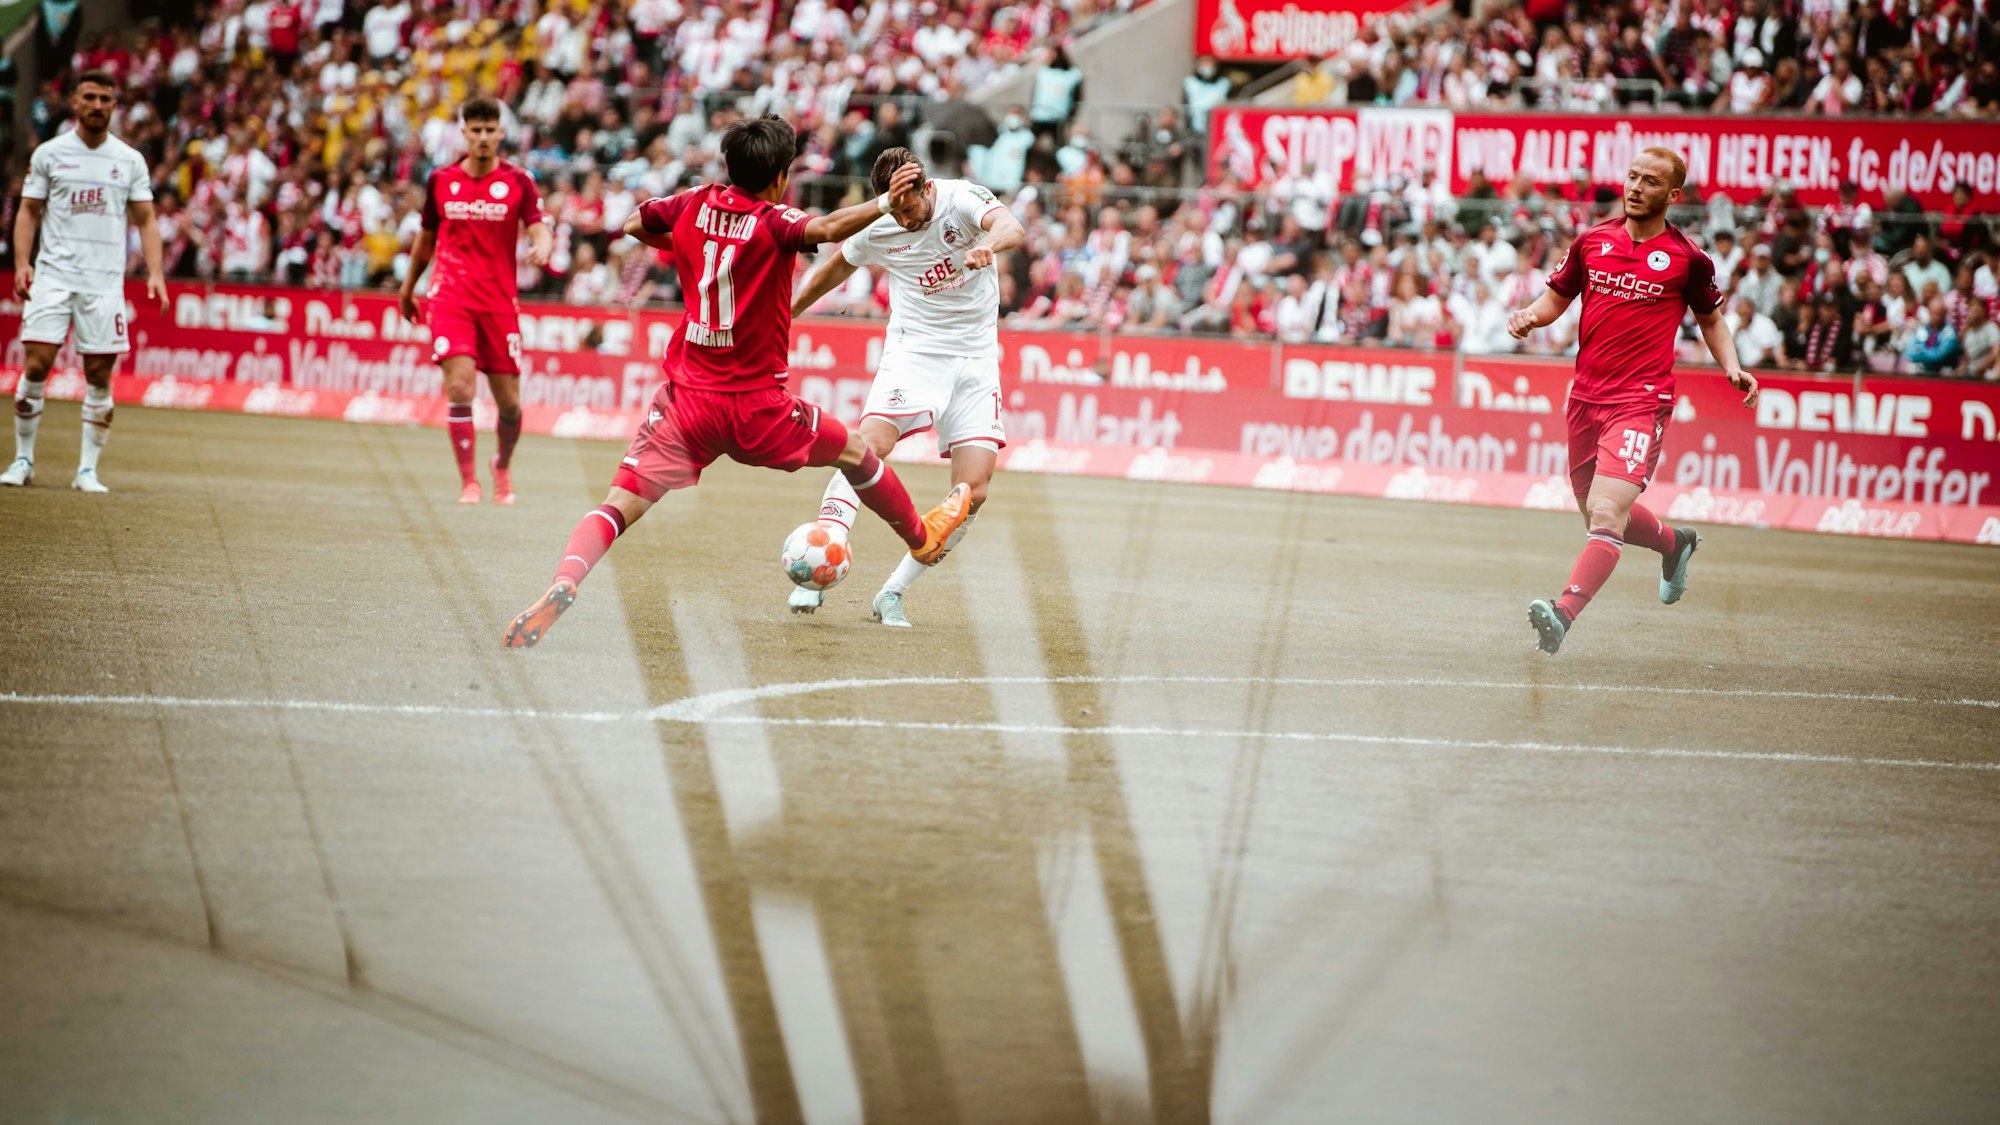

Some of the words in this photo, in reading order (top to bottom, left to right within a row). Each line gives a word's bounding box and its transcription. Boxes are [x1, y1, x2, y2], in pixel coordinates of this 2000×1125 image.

[71, 187, 105, 205] LEBE
[698, 239, 736, 330] 11
[1588, 269, 1664, 296] SCHÜCO
[1613, 289, 1631, 300] und
[115, 313, 124, 336] 6
[1619, 429, 1651, 463] 39
